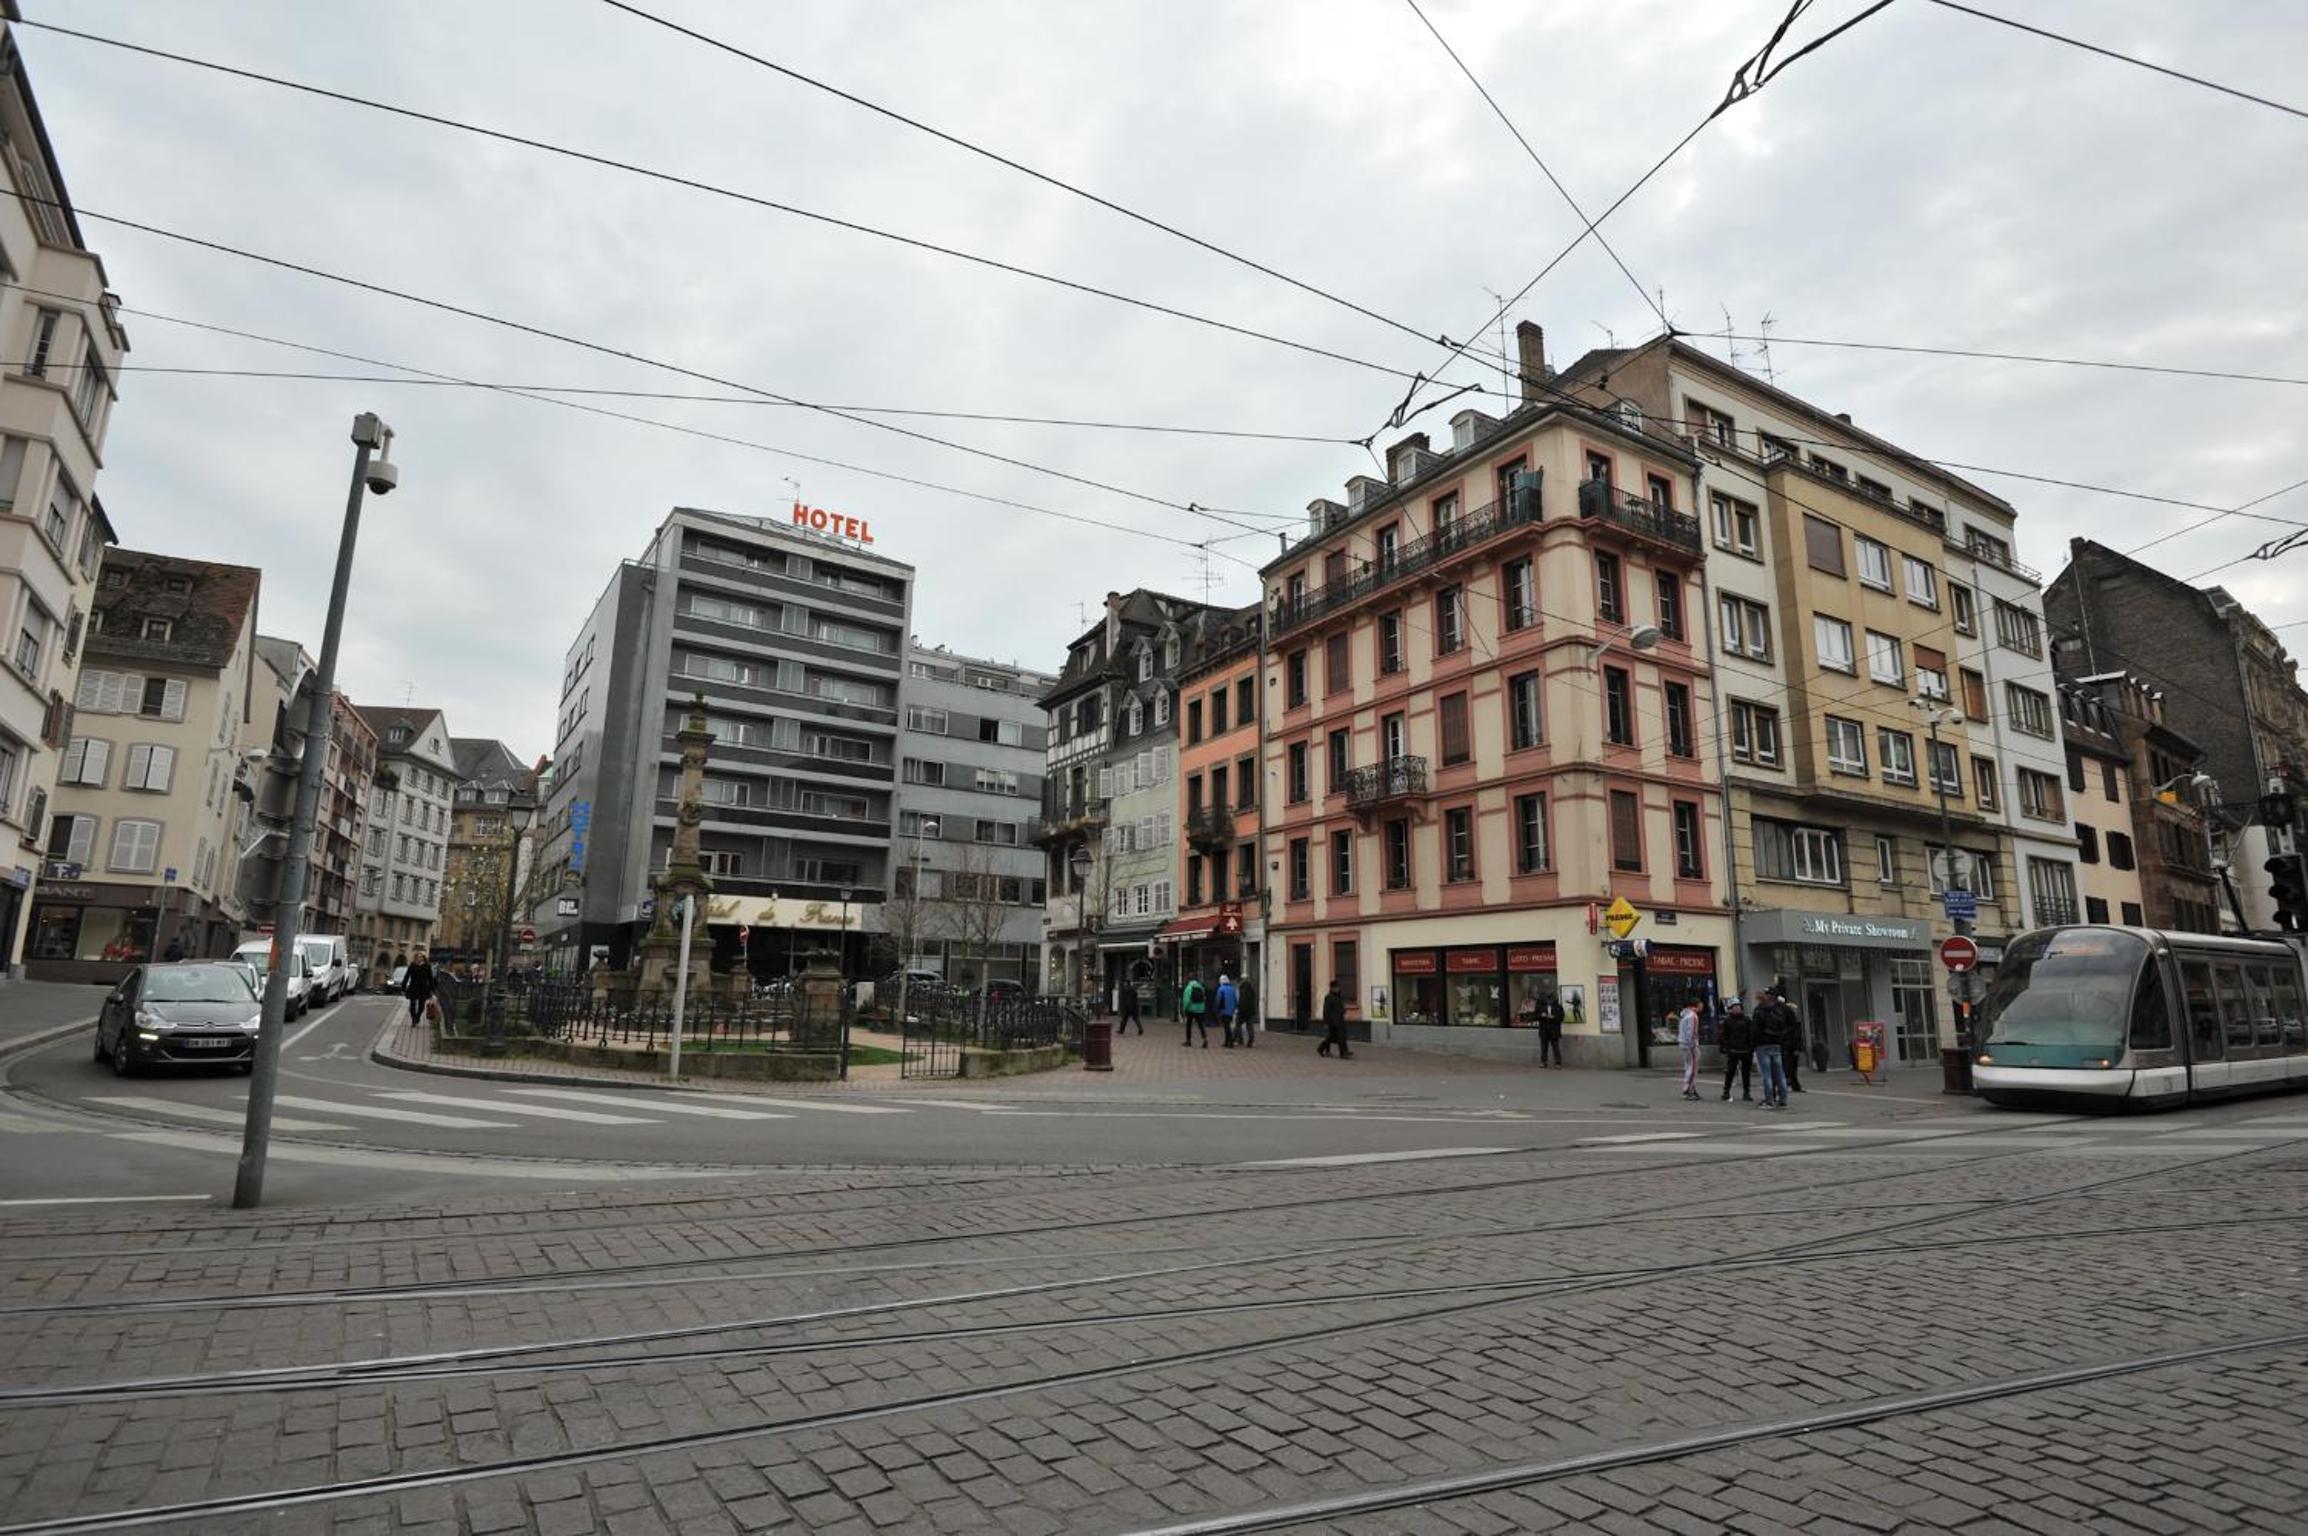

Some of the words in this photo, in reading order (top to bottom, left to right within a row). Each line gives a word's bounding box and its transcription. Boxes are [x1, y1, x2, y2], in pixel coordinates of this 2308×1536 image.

[793, 503, 874, 543] HOTEL
[1814, 919, 1829, 936] My
[1831, 919, 1862, 936] Private
[1866, 922, 1909, 939] Showroom
